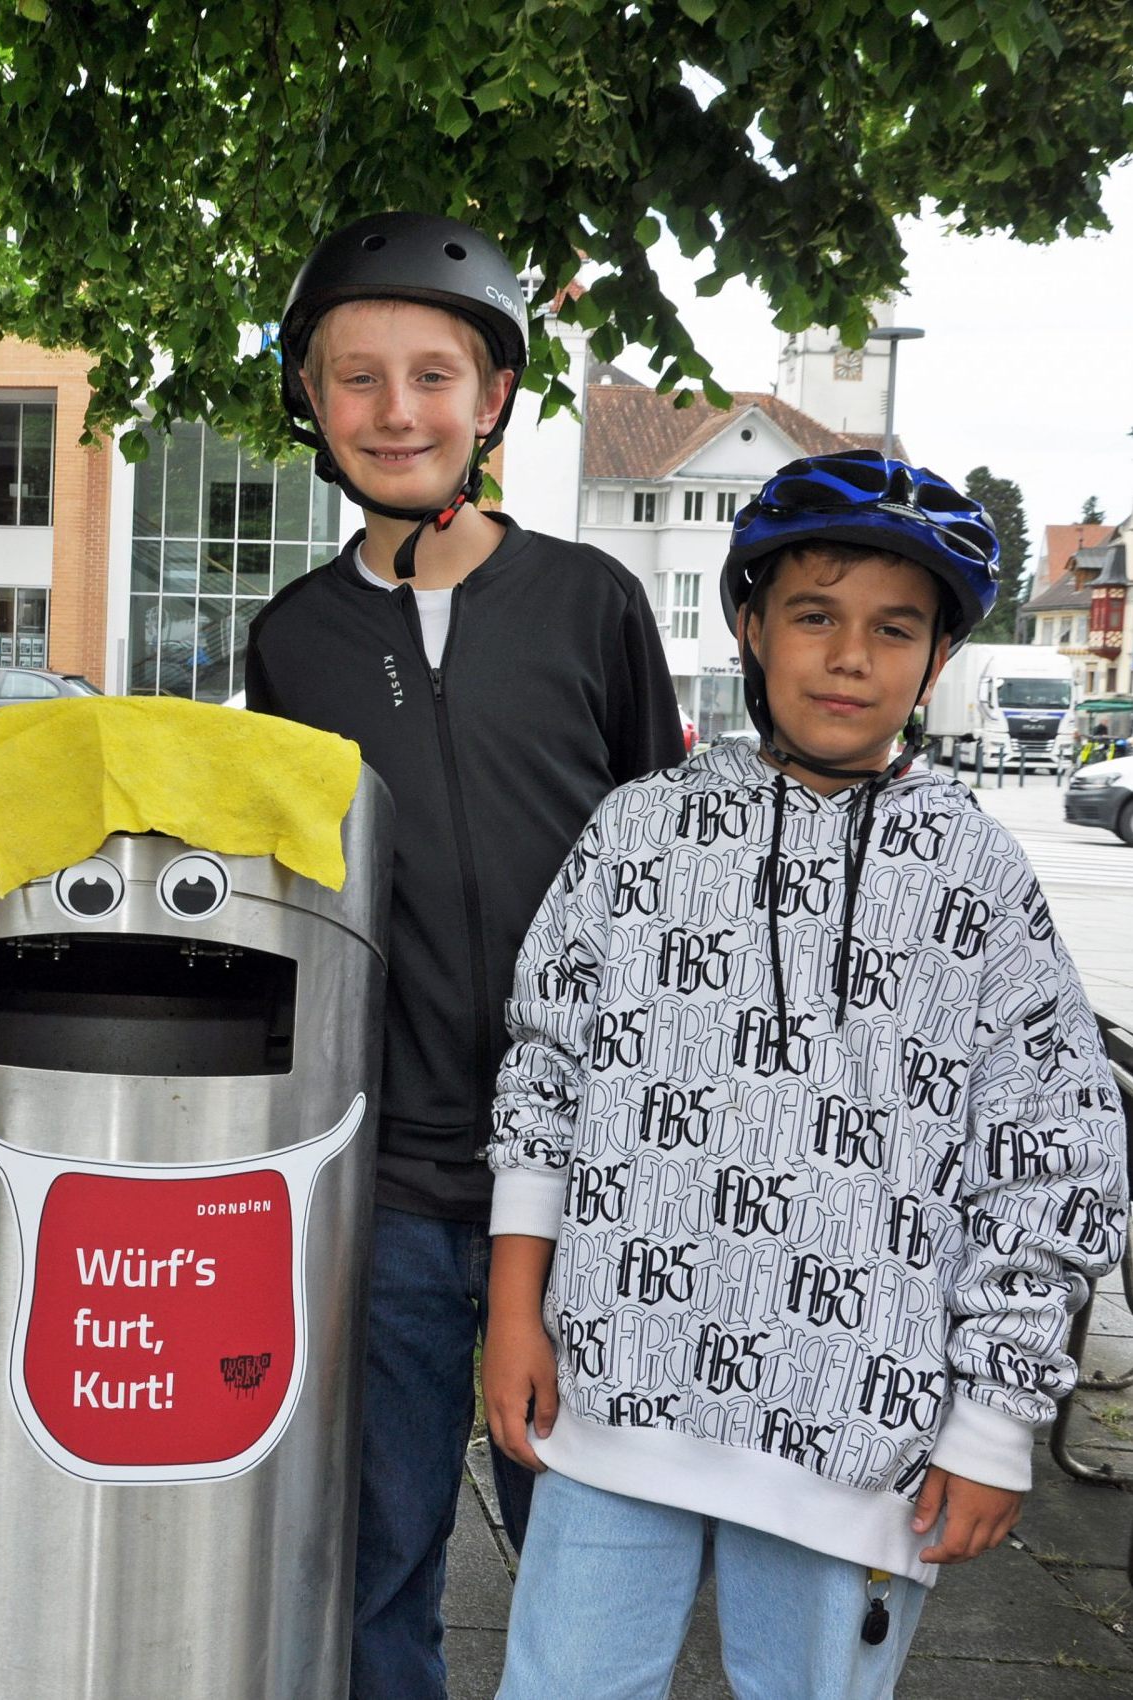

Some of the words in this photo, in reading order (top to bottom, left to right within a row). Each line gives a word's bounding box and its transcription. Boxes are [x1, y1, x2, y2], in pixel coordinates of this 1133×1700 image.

[383, 655, 404, 707] KIPSTA
[867, 810, 959, 861] BS
[612, 857, 663, 917] BS
[933, 884, 997, 960] FB
[591, 1007, 648, 1072] BS
[197, 1199, 272, 1217] DORNBIRN
[890, 1195, 931, 1270] FB
[73, 1307, 165, 1355] furt,
[72, 1370, 175, 1410] Kurt!
